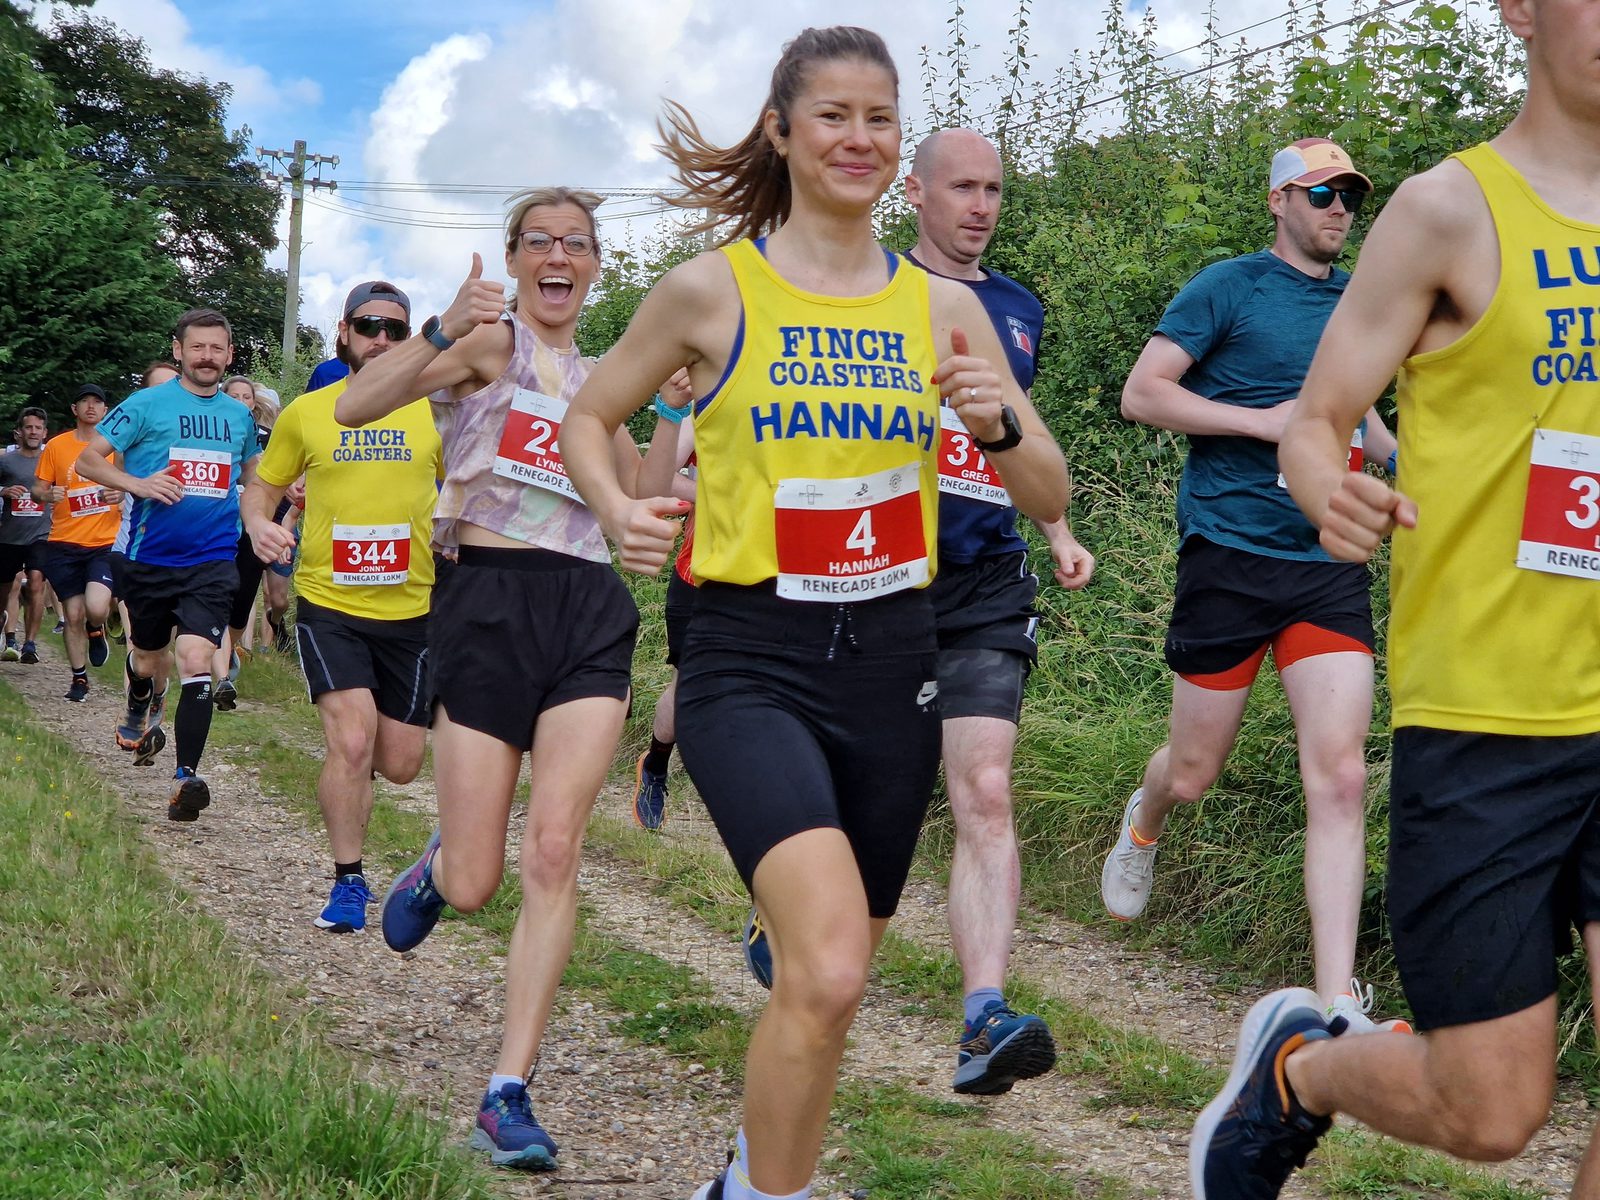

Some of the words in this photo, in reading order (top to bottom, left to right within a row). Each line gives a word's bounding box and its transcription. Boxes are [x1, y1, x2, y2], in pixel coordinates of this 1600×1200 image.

[1546, 307, 1600, 349] FI
[779, 326, 908, 364] FINCH
[769, 361, 924, 394] COASTERS
[1532, 352, 1600, 386] COA
[179, 415, 232, 443] BULLA
[340, 429, 406, 446] FINCH
[750, 401, 935, 452] HANNAH
[333, 448, 412, 462] COASTERS
[181, 461, 220, 482] 360
[510, 464, 564, 488] RENEGADE
[961, 469, 990, 483] GREG
[76, 493, 99, 507] 181
[938, 477, 984, 495] ENEGADE
[986, 488, 1006, 500] 10KM
[846, 509, 877, 556] 4
[347, 541, 397, 565] 344
[829, 554, 890, 574] HANNAH
[343, 574, 380, 582] RENEGADE
[358, 565, 386, 573] JONNY
[802, 578, 877, 594] RENEGADE
[881, 567, 910, 588] 10KM
